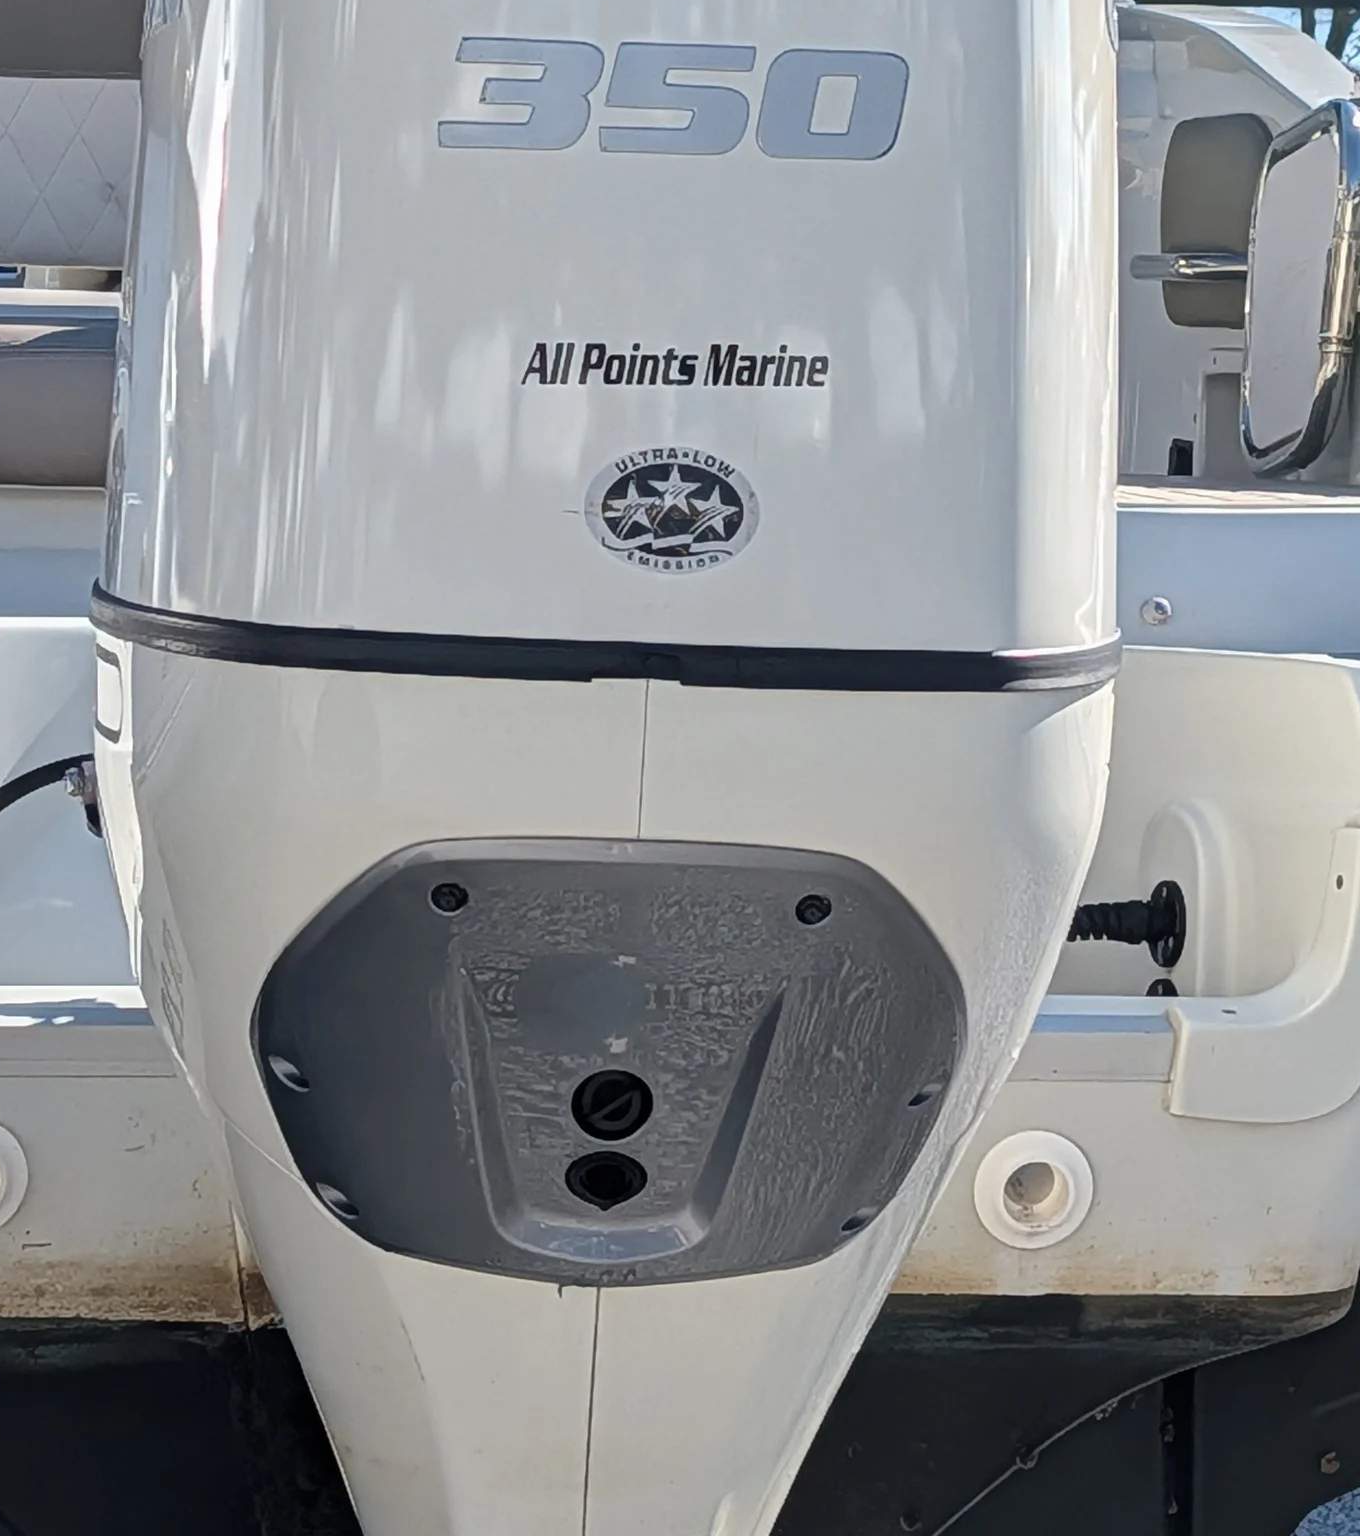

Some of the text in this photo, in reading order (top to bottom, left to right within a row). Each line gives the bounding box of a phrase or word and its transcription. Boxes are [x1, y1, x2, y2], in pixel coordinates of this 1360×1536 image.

[438, 36, 910, 161] 350
[521, 342, 829, 387] All Points Marine
